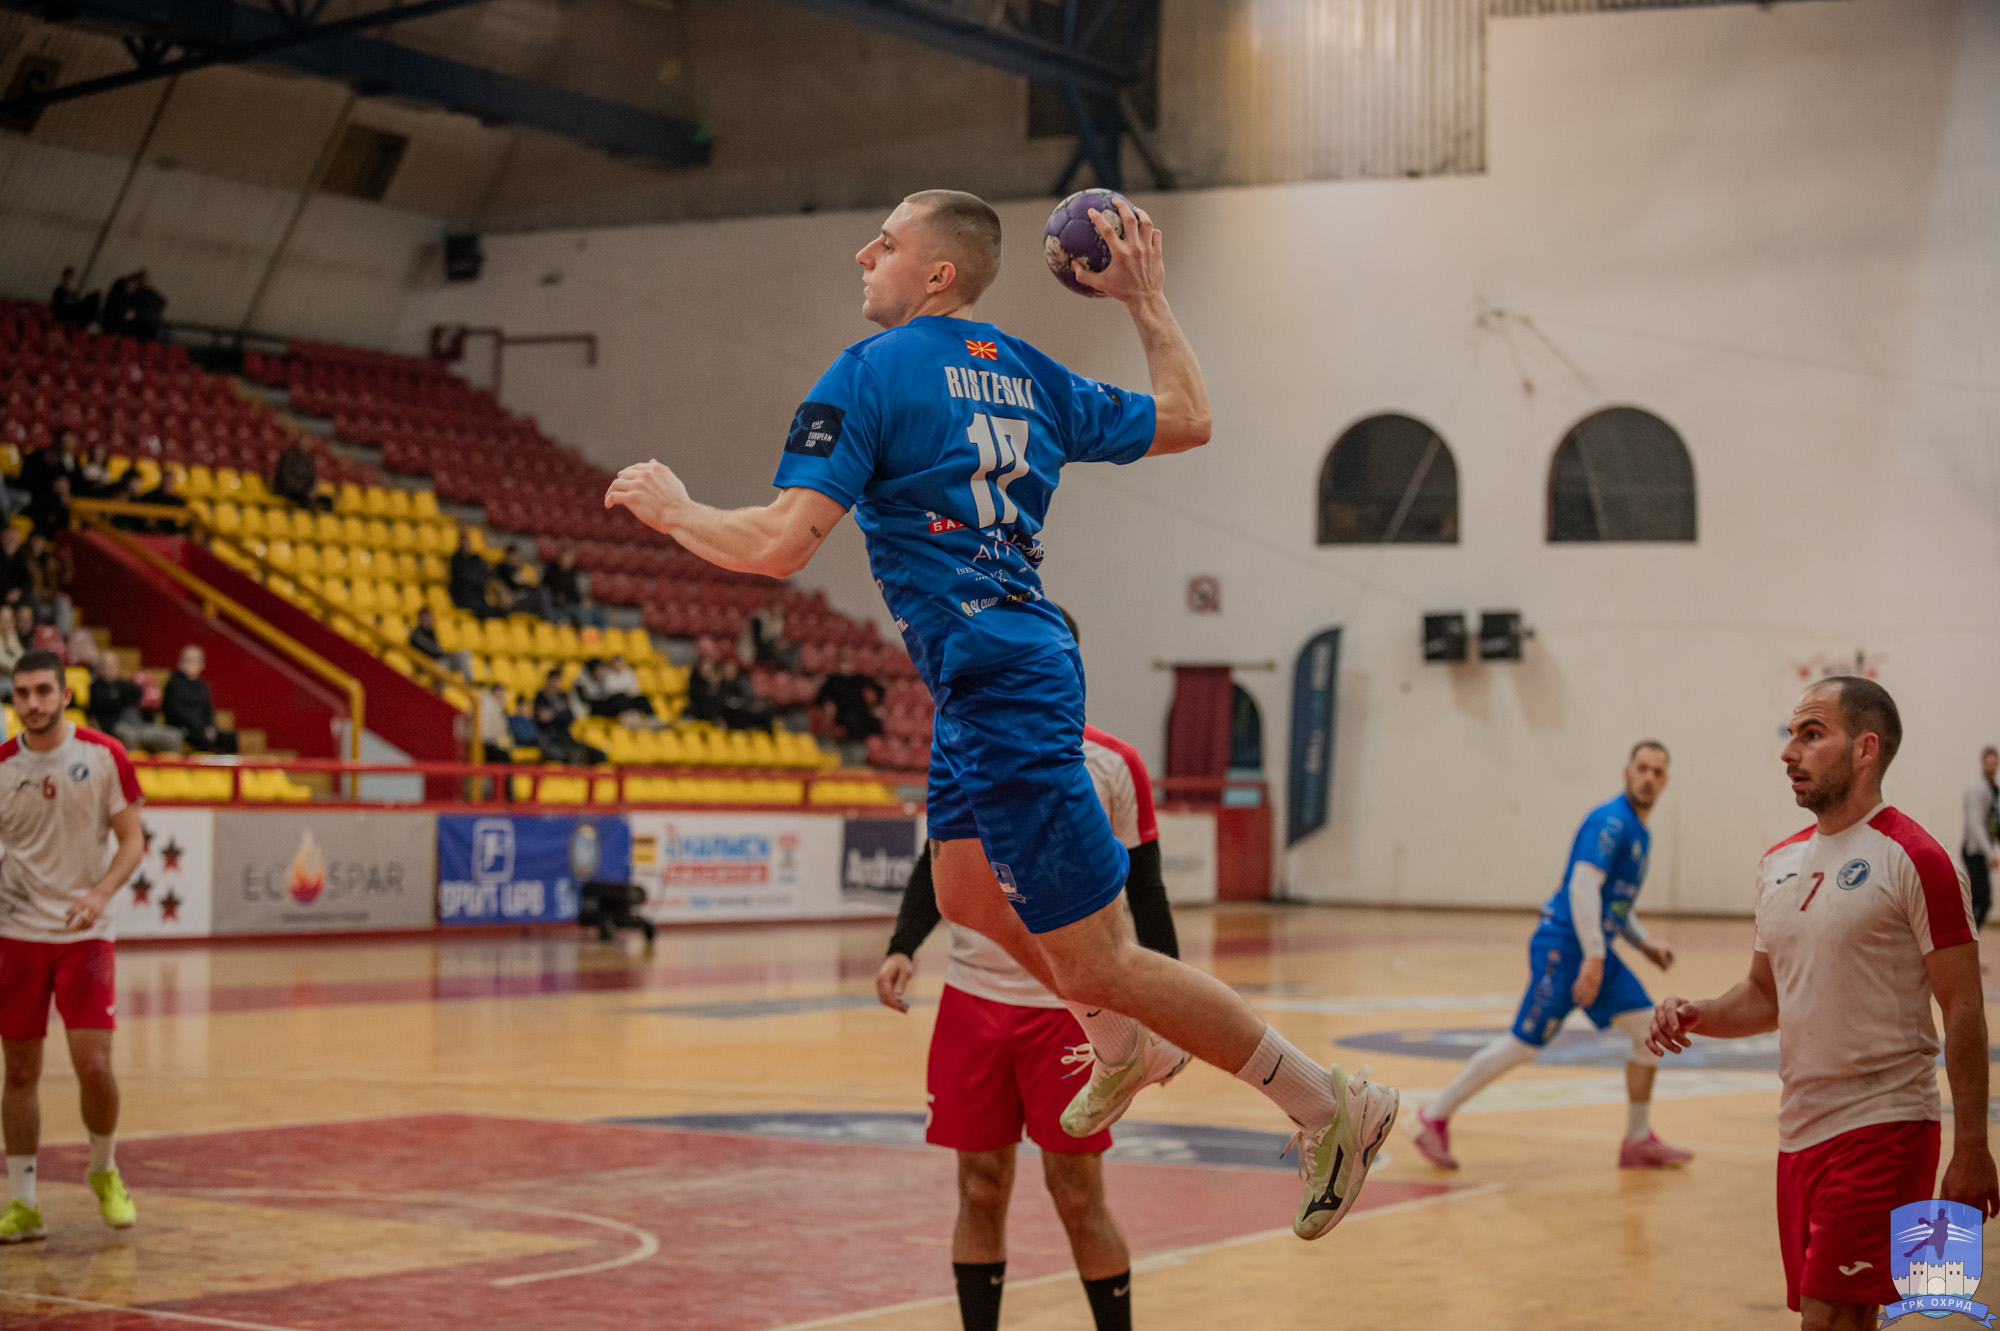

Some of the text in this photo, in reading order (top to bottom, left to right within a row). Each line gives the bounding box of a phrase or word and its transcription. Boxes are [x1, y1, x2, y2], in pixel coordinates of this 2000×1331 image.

[944, 366, 1035, 410] RISTESKI
[805, 440, 817, 448] CUP
[808, 431, 832, 442] EUROPEAN
[966, 412, 1029, 530] 17
[933, 519, 965, 532] БА
[980, 597, 999, 610] CLUB
[43, 775, 57, 800] 6
[1799, 871, 1825, 912] 7
